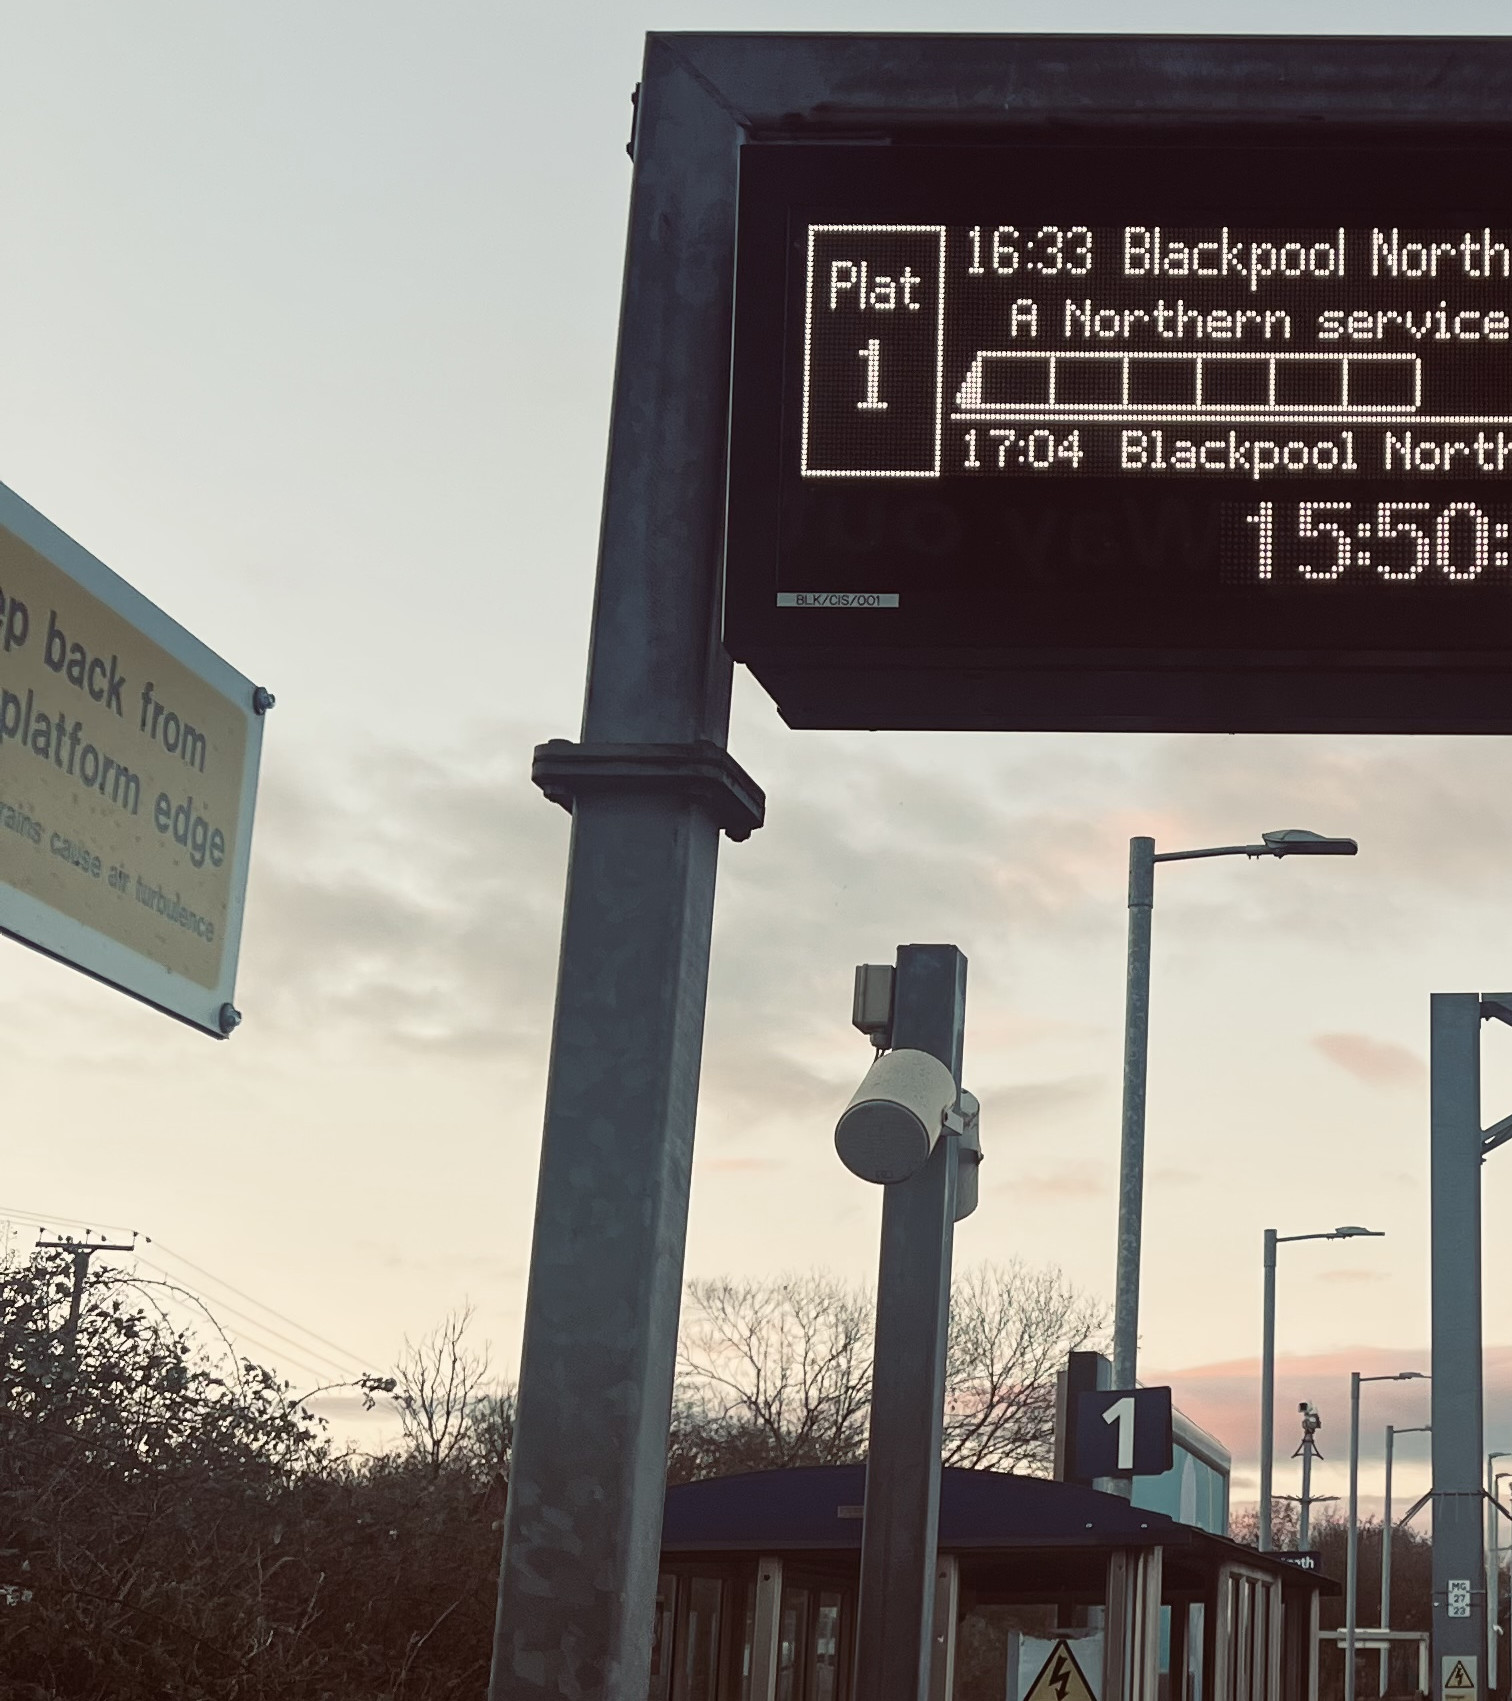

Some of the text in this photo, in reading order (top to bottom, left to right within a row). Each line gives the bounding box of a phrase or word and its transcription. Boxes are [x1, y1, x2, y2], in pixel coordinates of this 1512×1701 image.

[829, 259, 921, 312] Plat
[968, 225, 1510, 292] 16:33 Blackpool North
[1010, 298, 1038, 338] A
[1064, 299, 1291, 339] Northern
[1318, 300, 1510, 340] service
[856, 338, 889, 410] 1
[963, 428, 1084, 469] 17:04
[1121, 429, 1358, 480] Blackpool
[796, 594, 880, 606] BLK/CIS/001
[44, 609, 126, 718] back
[138, 681, 207, 773] from
[0, 687, 225, 869] platform edge
[50, 832, 101, 879] cause
[108, 865, 130, 893] air
[135, 875, 214, 943] turbulence
[1101, 1397, 1135, 1469] 1
[1452, 1582, 1467, 1591] MG
[1454, 1594, 1466, 1603] 27
